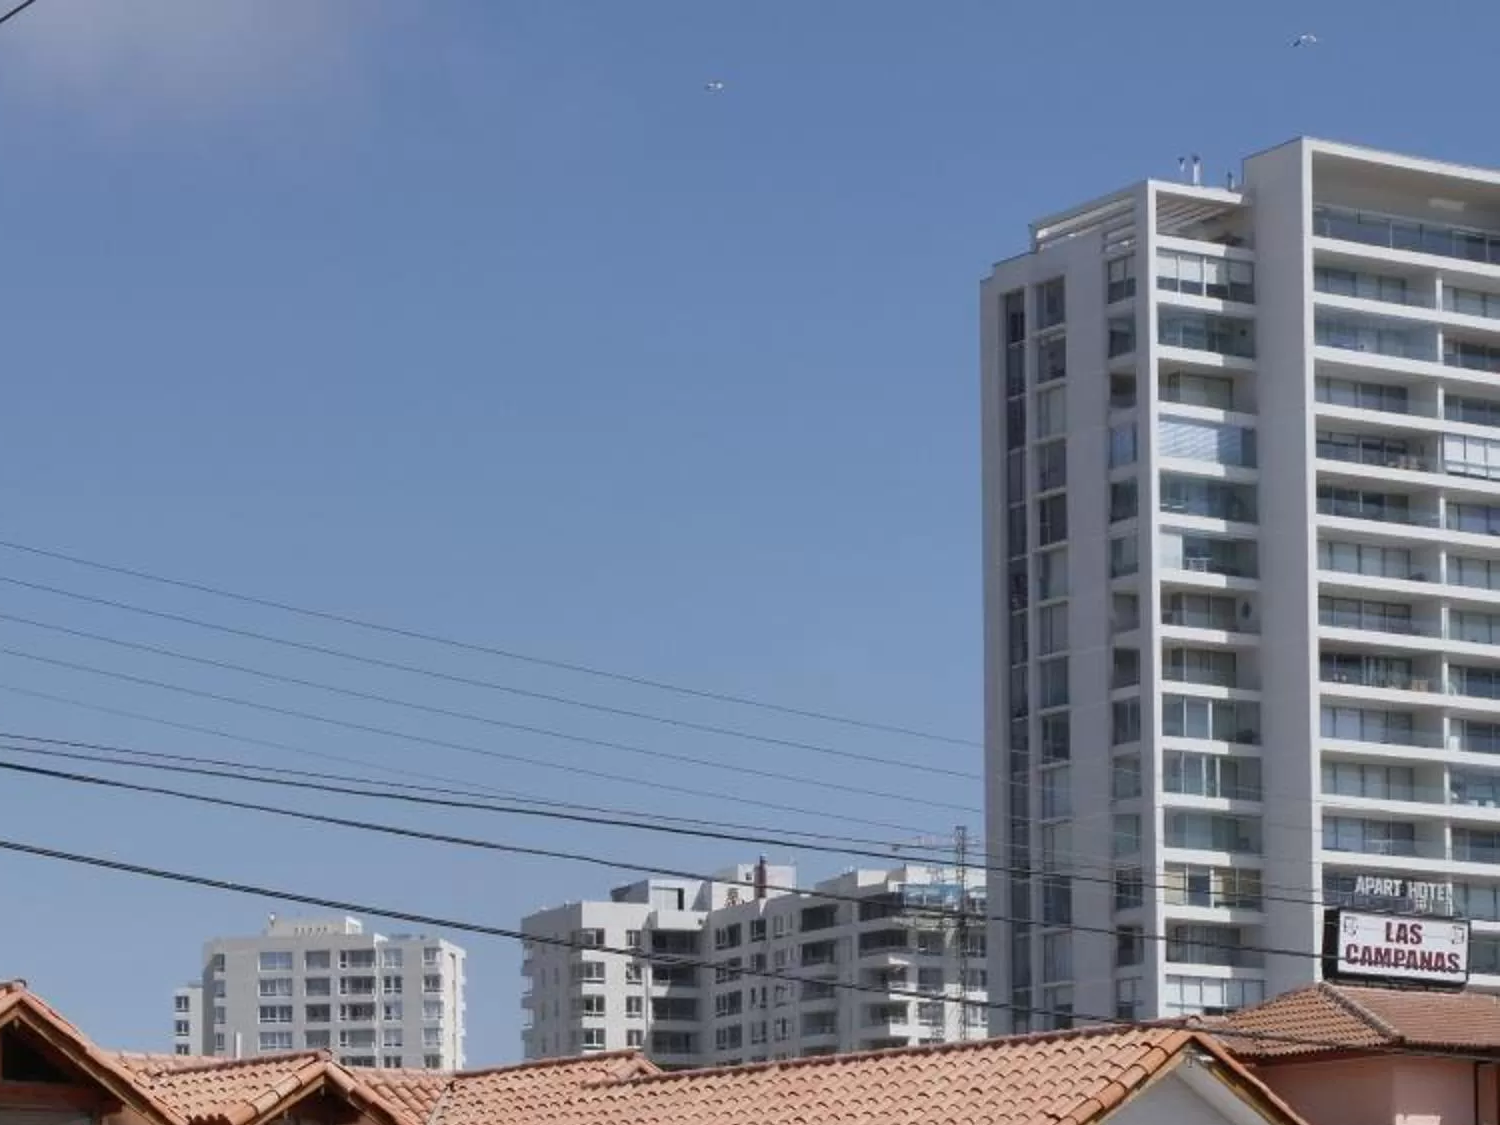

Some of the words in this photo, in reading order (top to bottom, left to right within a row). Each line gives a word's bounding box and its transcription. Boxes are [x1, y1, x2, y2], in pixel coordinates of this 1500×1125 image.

[1354, 876, 1403, 897] APART
[1385, 922, 1423, 945] LAS
[1345, 944, 1461, 974] CAMPANAS
